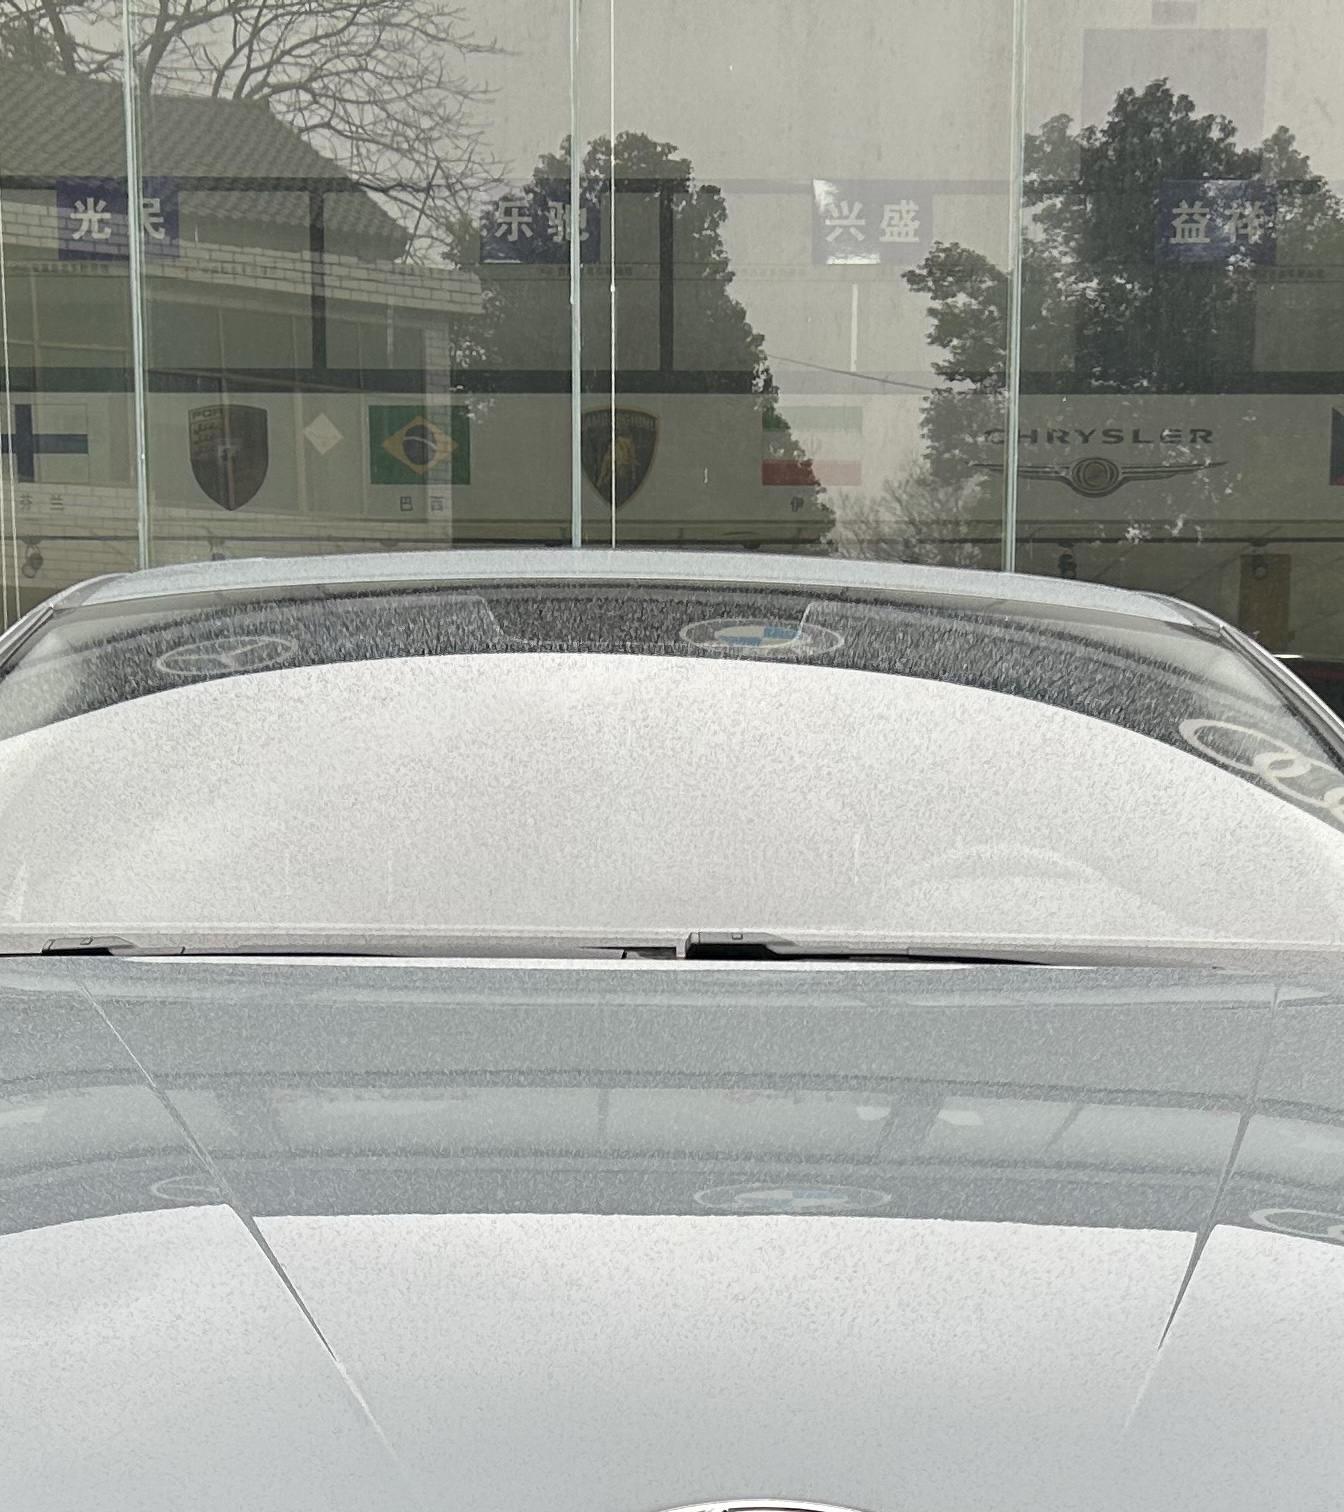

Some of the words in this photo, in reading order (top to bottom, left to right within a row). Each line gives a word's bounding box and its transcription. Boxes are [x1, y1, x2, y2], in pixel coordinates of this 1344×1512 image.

[825, 200, 920, 243] 兴盛
[984, 428, 1215, 446] CHRYSLER
[19, 494, 64, 511] 芬兰
[399, 496, 445, 513] 巴西
